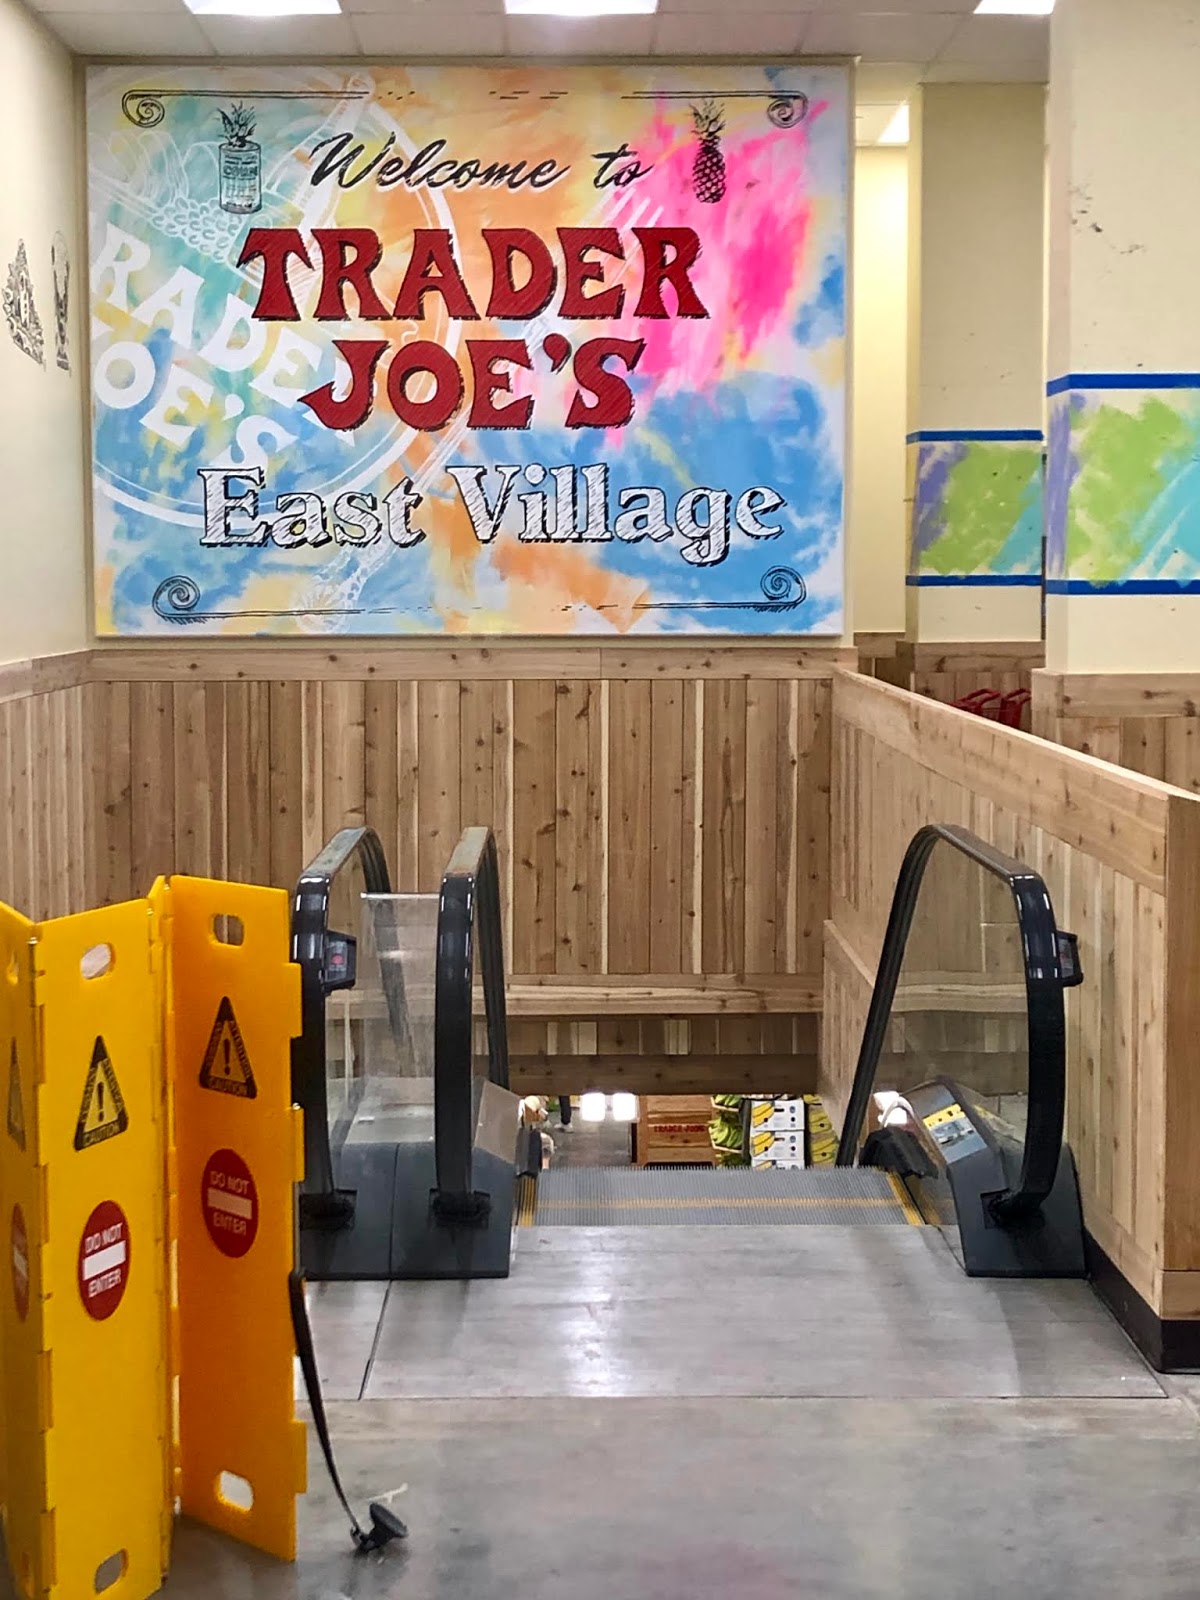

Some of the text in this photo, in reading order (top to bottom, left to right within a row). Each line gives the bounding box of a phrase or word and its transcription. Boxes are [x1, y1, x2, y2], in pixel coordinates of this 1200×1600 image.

[308, 131, 654, 189] Welcome to
[236, 227, 711, 321] TRADER
[297, 332, 647, 432] JOE'S
[197, 463, 788, 567] East Village
[210, 1170, 250, 1195] DO NOT
[85, 1222, 123, 1254] DO NOT
[213, 1211, 247, 1236] ENTER
[88, 1268, 122, 1298] ENTER
